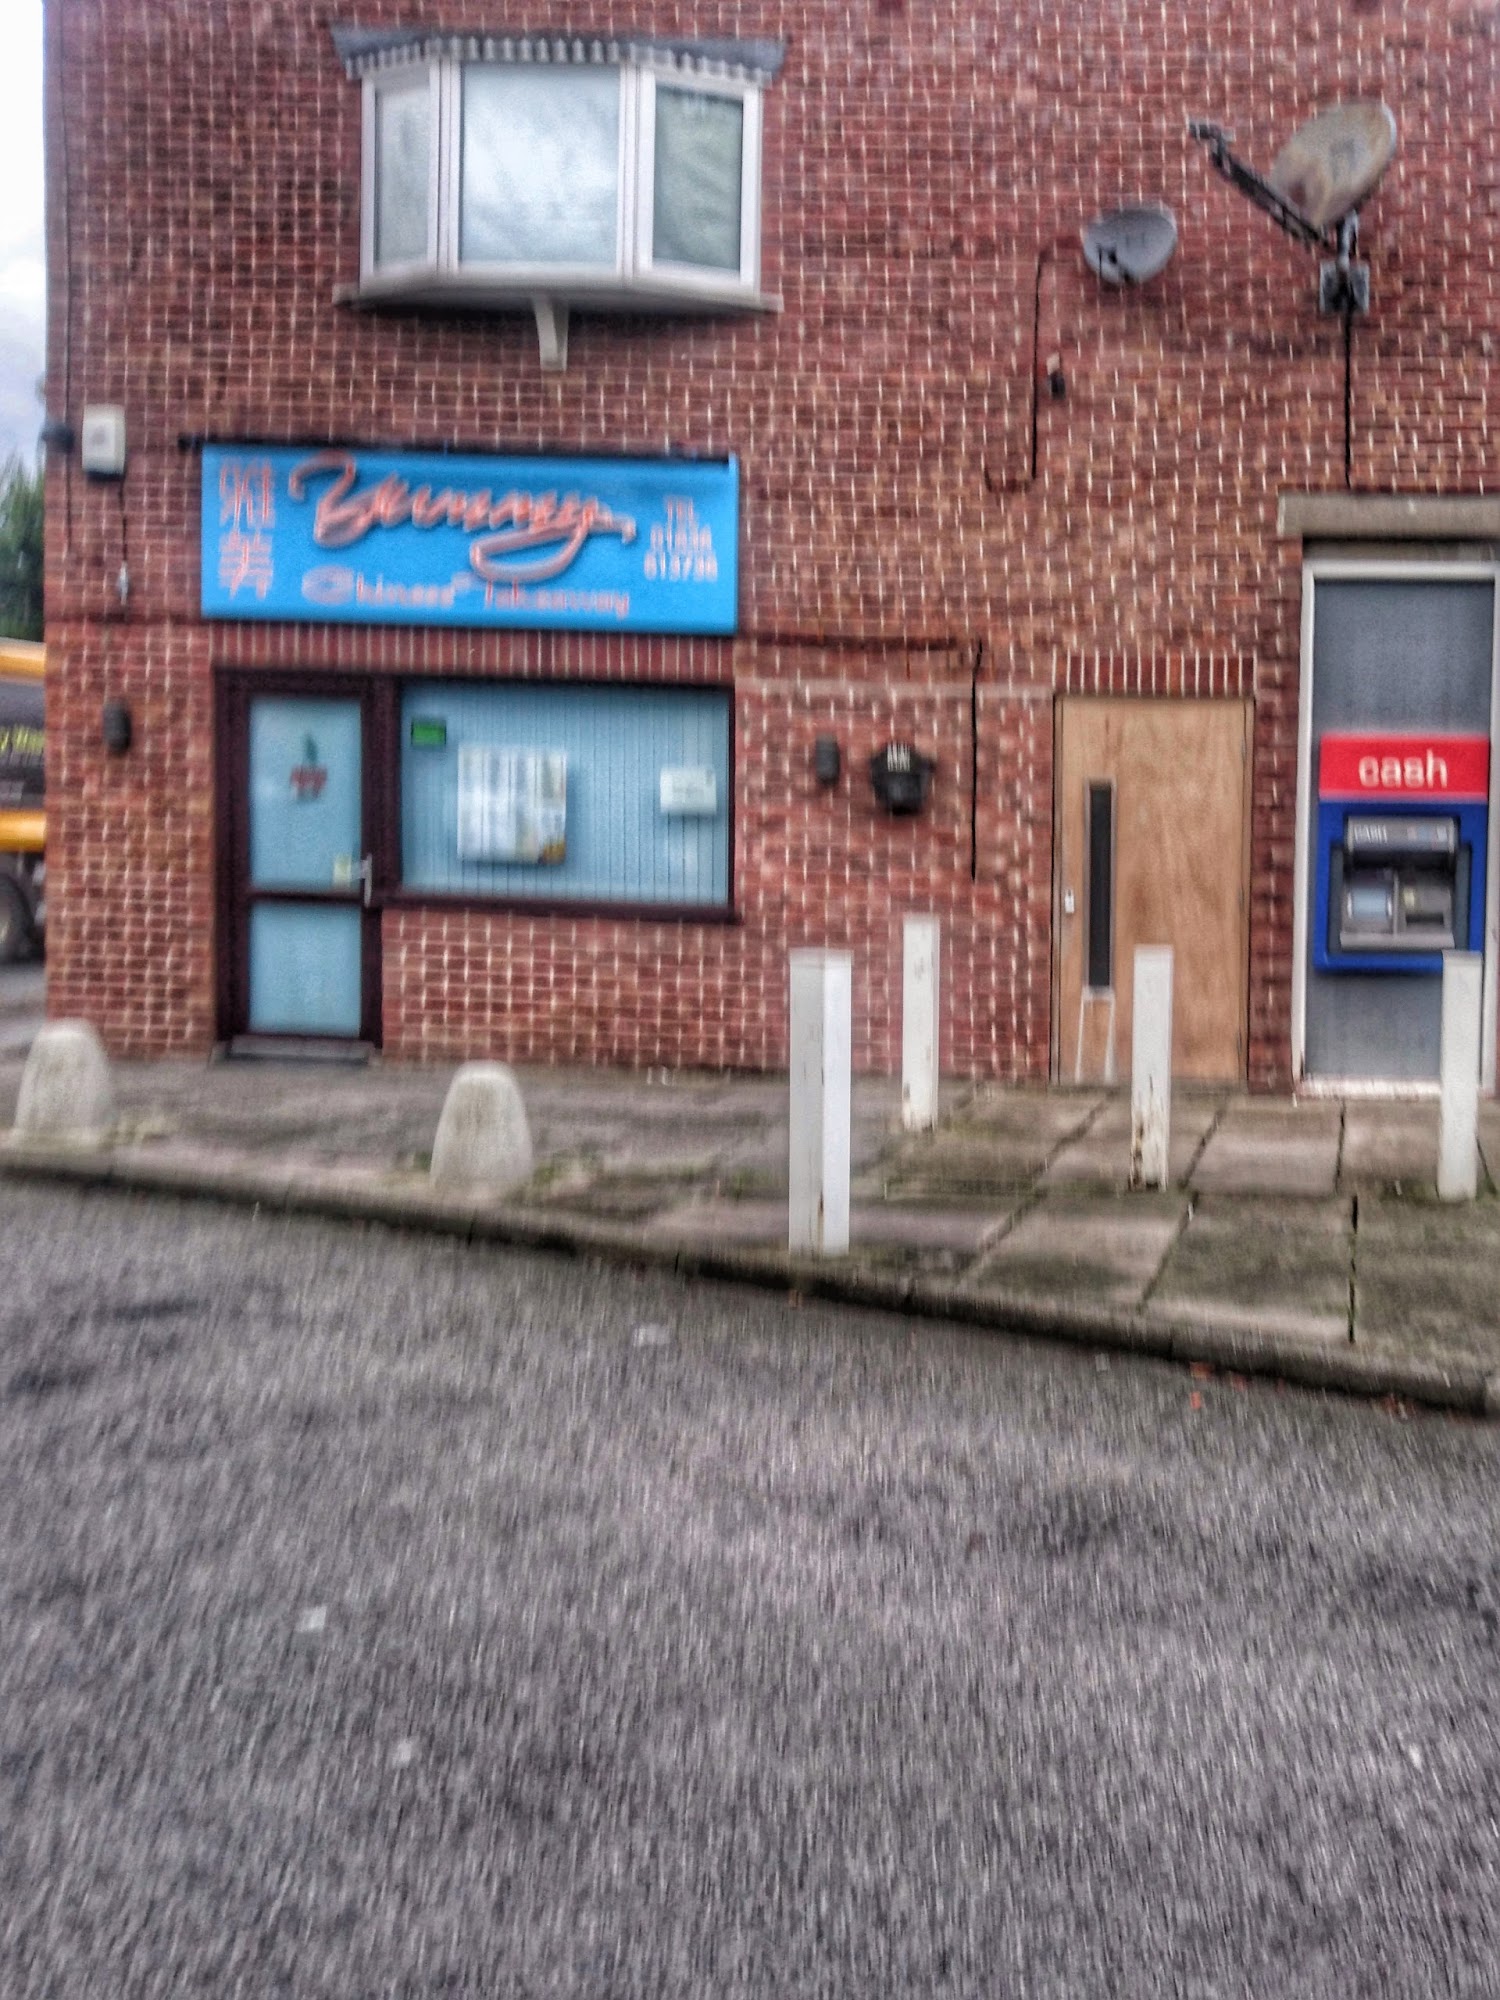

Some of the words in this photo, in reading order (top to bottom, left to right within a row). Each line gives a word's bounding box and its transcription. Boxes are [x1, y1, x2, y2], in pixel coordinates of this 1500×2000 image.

[302, 564, 458, 608] Chinese
[485, 576, 630, 620] Takeaway
[1358, 748, 1448, 789] cash
